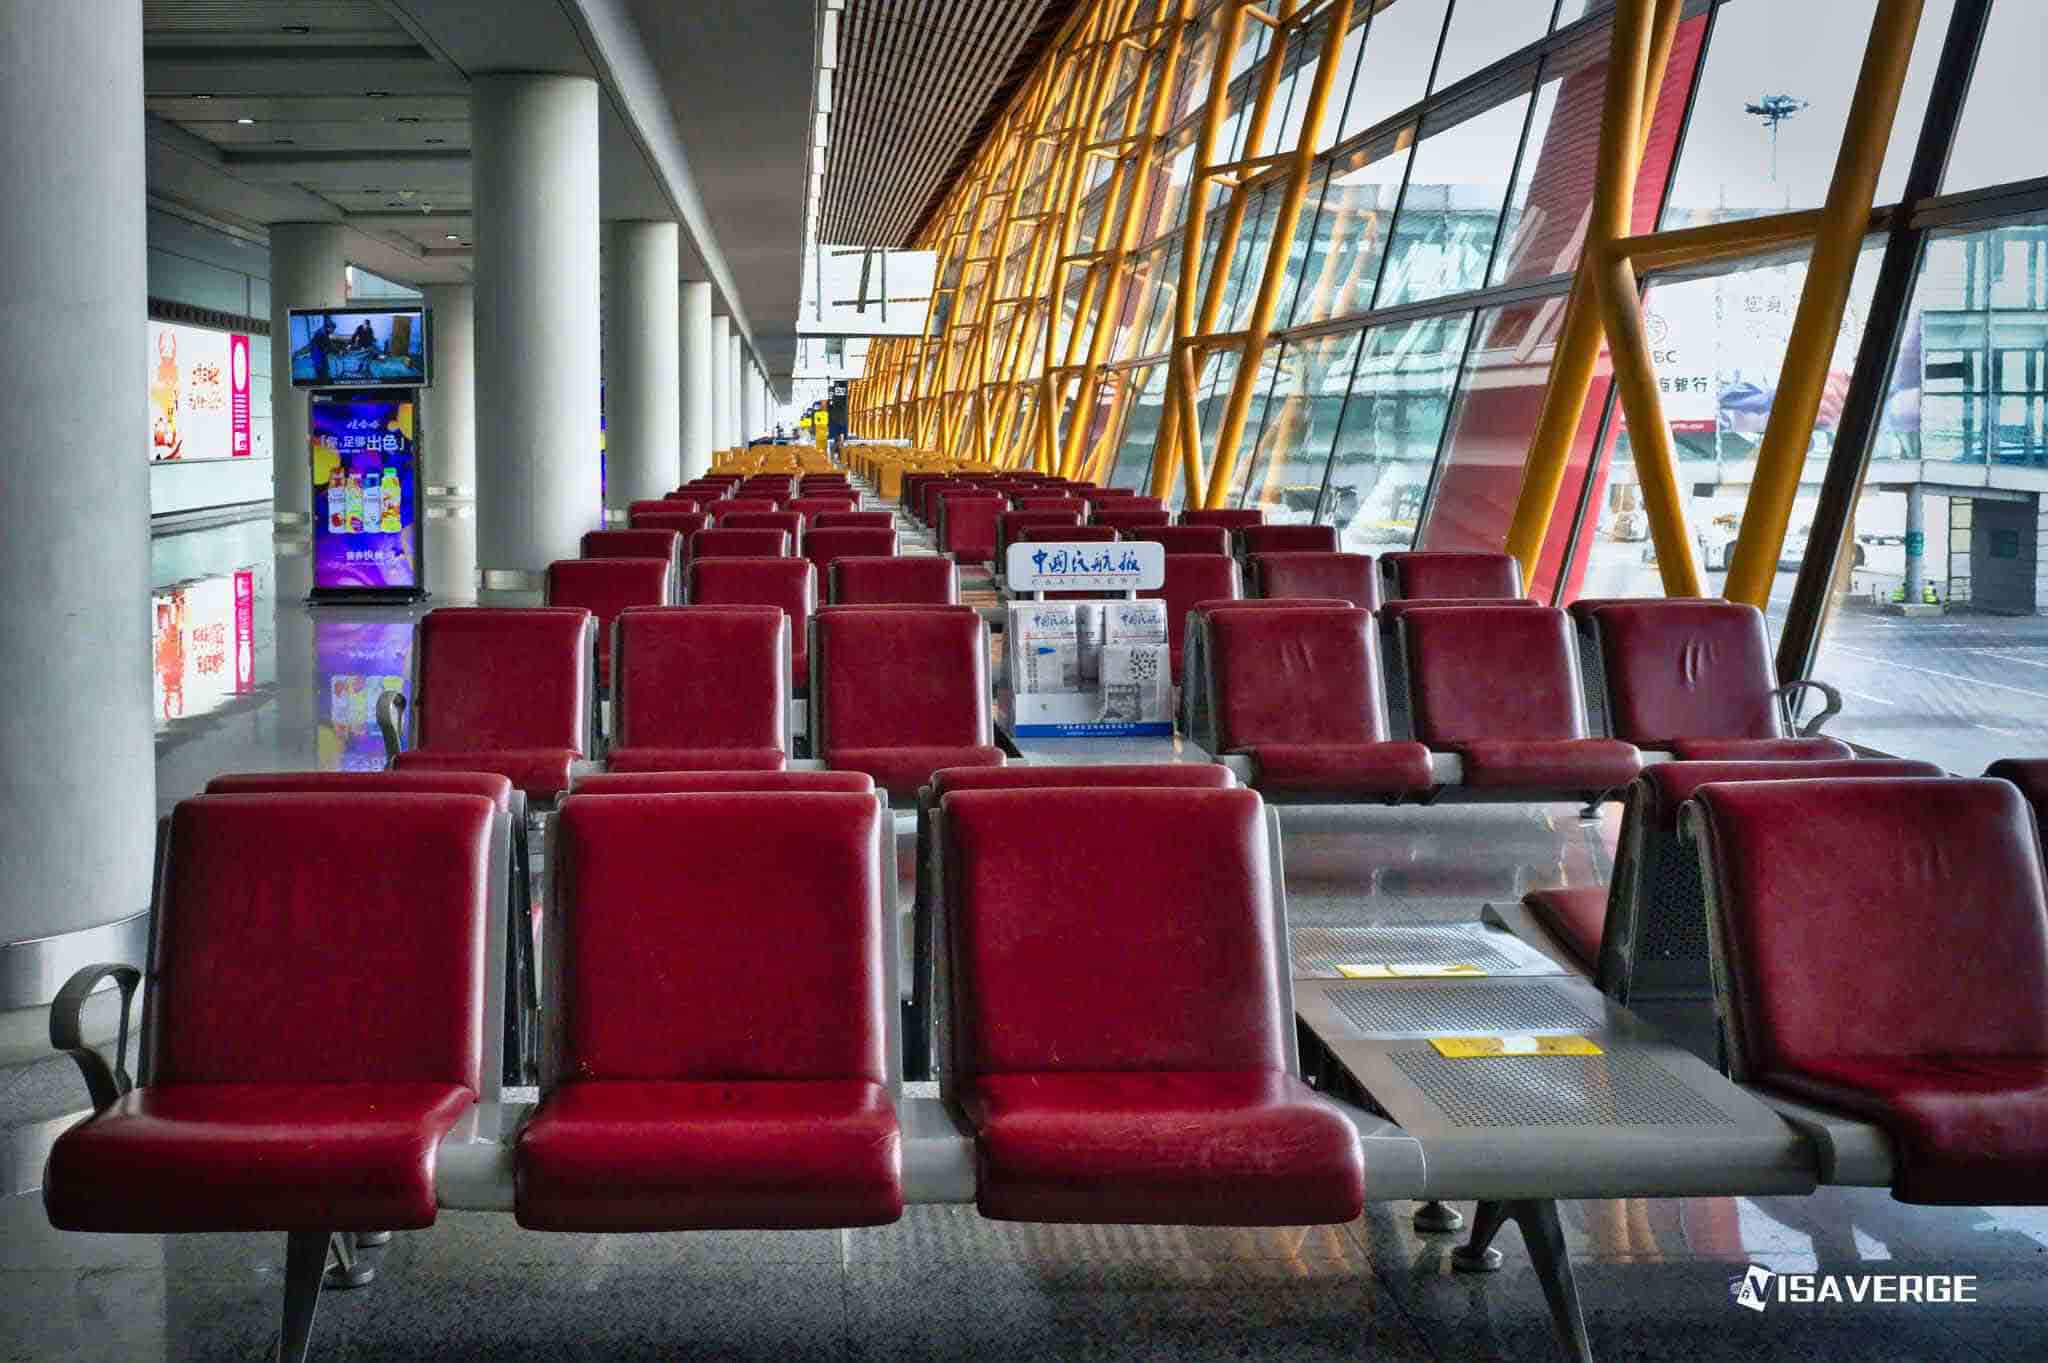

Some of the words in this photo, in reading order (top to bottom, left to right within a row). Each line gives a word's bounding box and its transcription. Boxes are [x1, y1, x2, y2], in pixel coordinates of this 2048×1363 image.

[1031, 549, 1141, 574] 中国民航报
